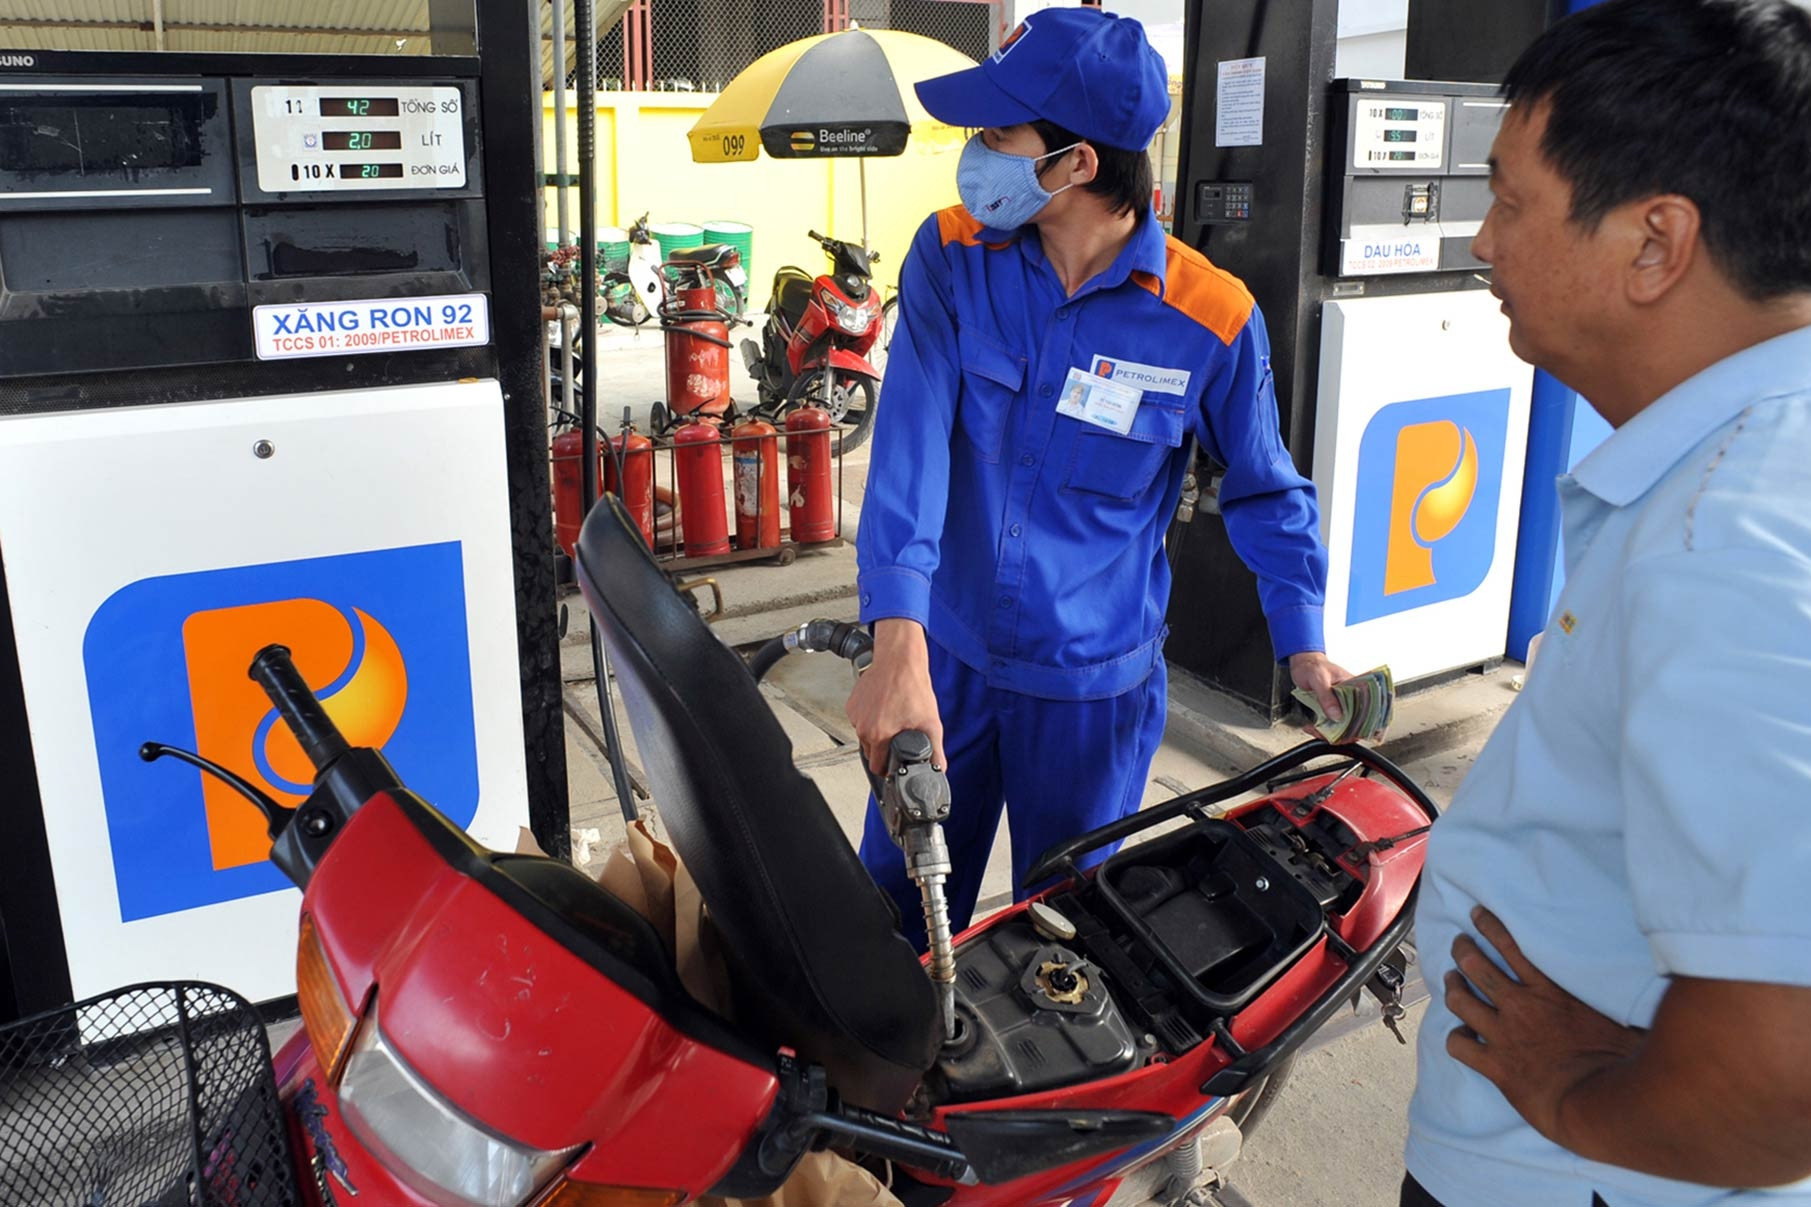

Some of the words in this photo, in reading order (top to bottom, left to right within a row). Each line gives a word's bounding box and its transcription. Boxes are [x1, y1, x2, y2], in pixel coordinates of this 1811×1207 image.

[0, 55, 34, 67] UNO
[347, 100, 370, 116] 42
[421, 131, 443, 146] LÍT
[723, 134, 745, 156] 099
[303, 164, 321, 179] 10
[272, 308, 359, 335] XĂNG
[369, 305, 432, 329] RON
[442, 304, 473, 324] 92
[273, 336, 314, 352] TCCS
[319, 334, 340, 349] 01:
[1115, 369, 1186, 388] PETROLIMEX
